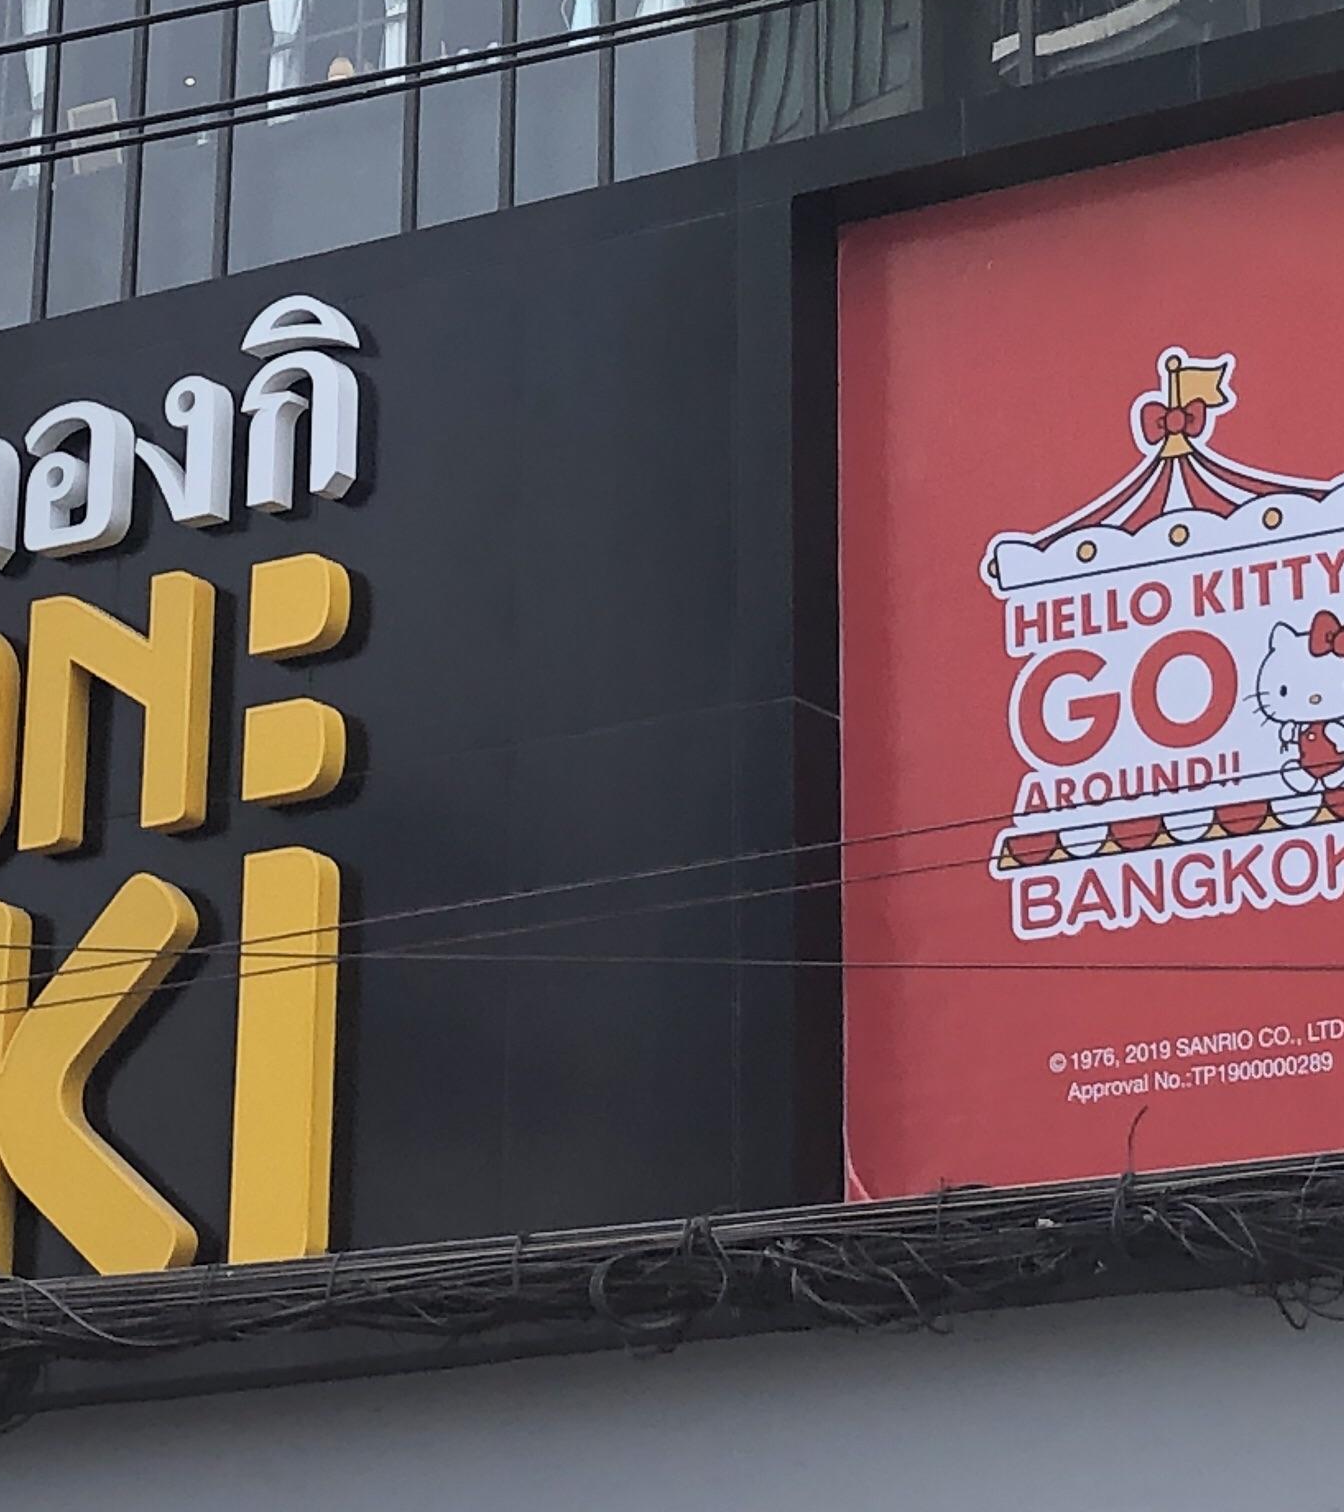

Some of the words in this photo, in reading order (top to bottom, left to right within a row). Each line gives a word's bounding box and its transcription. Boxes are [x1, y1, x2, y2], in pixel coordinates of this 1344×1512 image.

[1012, 580, 1173, 648] HELLO
[1018, 628, 1239, 768] GO
[1024, 750, 1242, 817] AROUND!!
[1125, 1037, 1171, 1065] 2019
[1176, 1029, 1254, 1058] SANRIO
[1067, 1073, 1150, 1105] Approval
